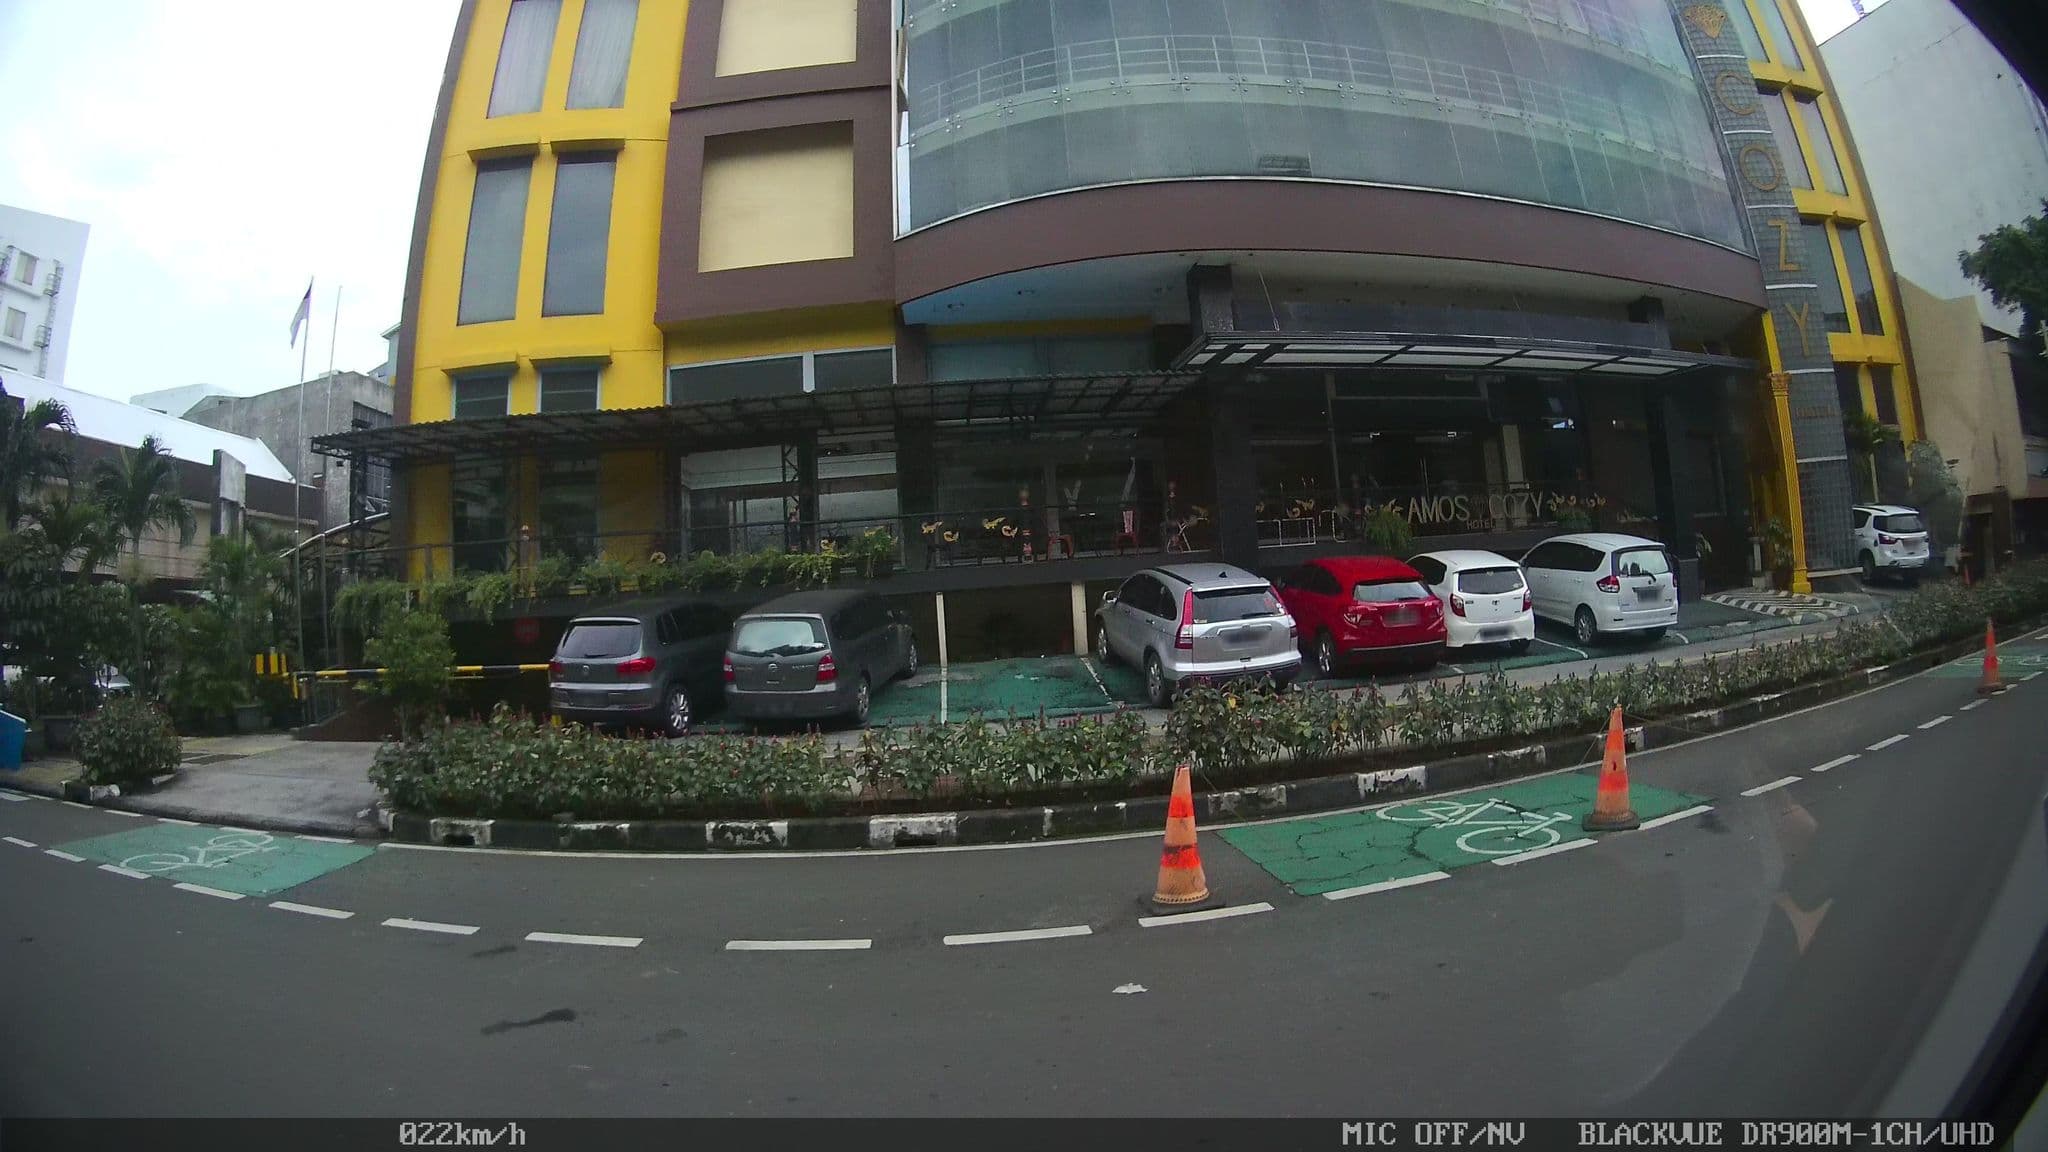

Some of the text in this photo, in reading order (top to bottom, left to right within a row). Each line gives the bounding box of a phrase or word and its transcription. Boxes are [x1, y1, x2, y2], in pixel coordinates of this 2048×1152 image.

[1715, 70, 1811, 357] COZY
[1407, 491, 1544, 524] AMOS COZY
[1466, 519, 1496, 530] HOTEL
